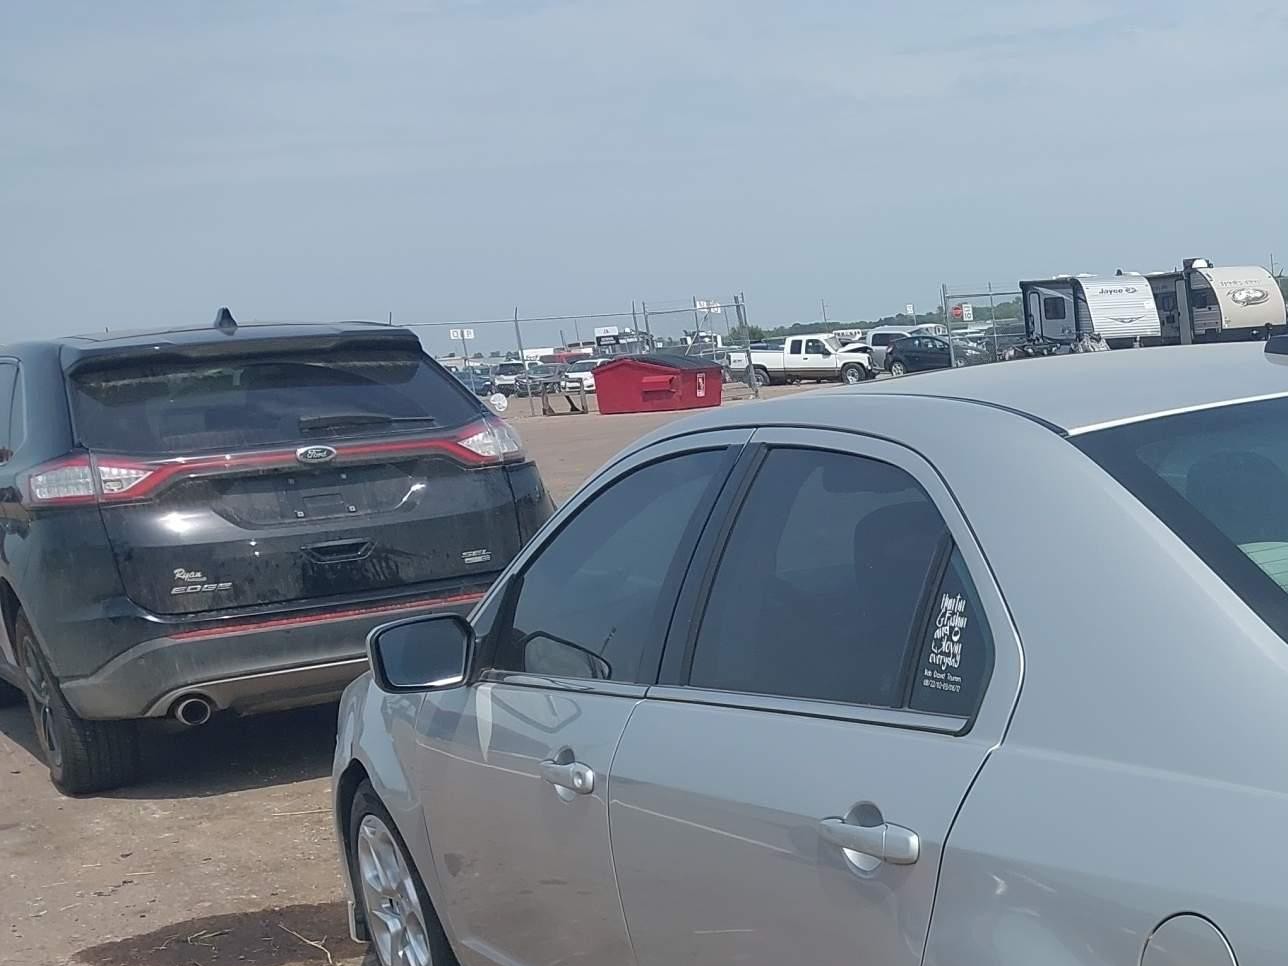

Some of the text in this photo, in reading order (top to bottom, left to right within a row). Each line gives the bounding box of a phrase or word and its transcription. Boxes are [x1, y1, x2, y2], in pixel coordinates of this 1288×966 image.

[306, 449, 328, 459] Ford
[173, 568, 207, 582] Ryan
[170, 582, 233, 595] EDGE
